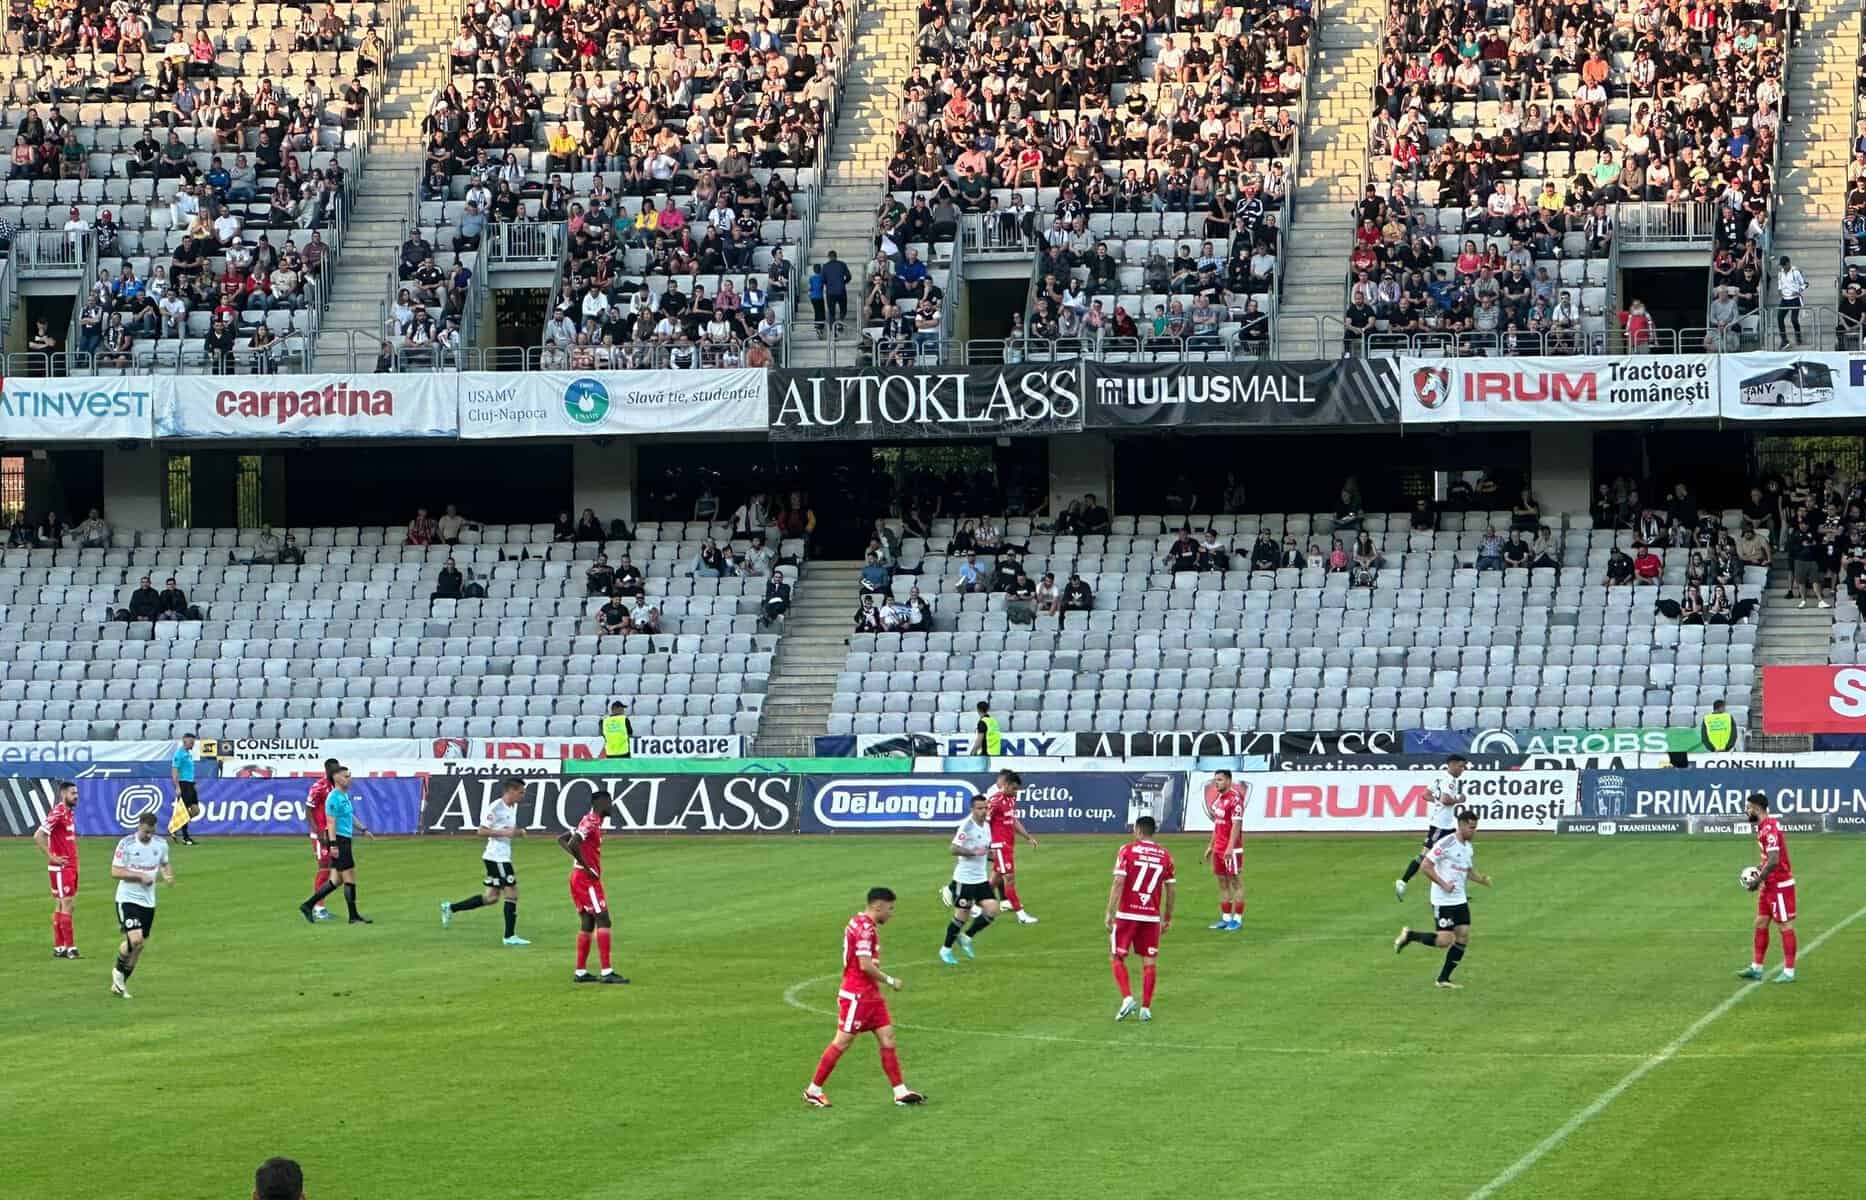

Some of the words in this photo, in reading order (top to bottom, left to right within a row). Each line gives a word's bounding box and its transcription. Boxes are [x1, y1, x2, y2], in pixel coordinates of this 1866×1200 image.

[1608, 361, 1707, 382] Tractoare
[467, 389, 516, 403] USAMV
[771, 367, 1080, 426] AUTOKLASS
[1463, 372, 1597, 401] IRUM
[215, 382, 393, 424] carpatina
[467, 407, 547, 424] Cluj-Napoca
[235, 739, 320, 750] CONSILIUL
[630, 736, 729, 755] Tractoare
[1524, 732, 1669, 753] AROBS
[1457, 775, 1564, 796] ractoare
[429, 776, 791, 831] ATOKLASS
[1264, 784, 1428, 818] IRUM
[1030, 805, 1064, 819] bean
[1068, 806, 1082, 819] to
[1085, 807, 1116, 822] cup.
[1837, 816, 1866, 825] BANCA
[1568, 824, 1596, 833] BANCA
[1703, 825, 1732, 834] BANCA
[1132, 860, 1163, 894] 77
